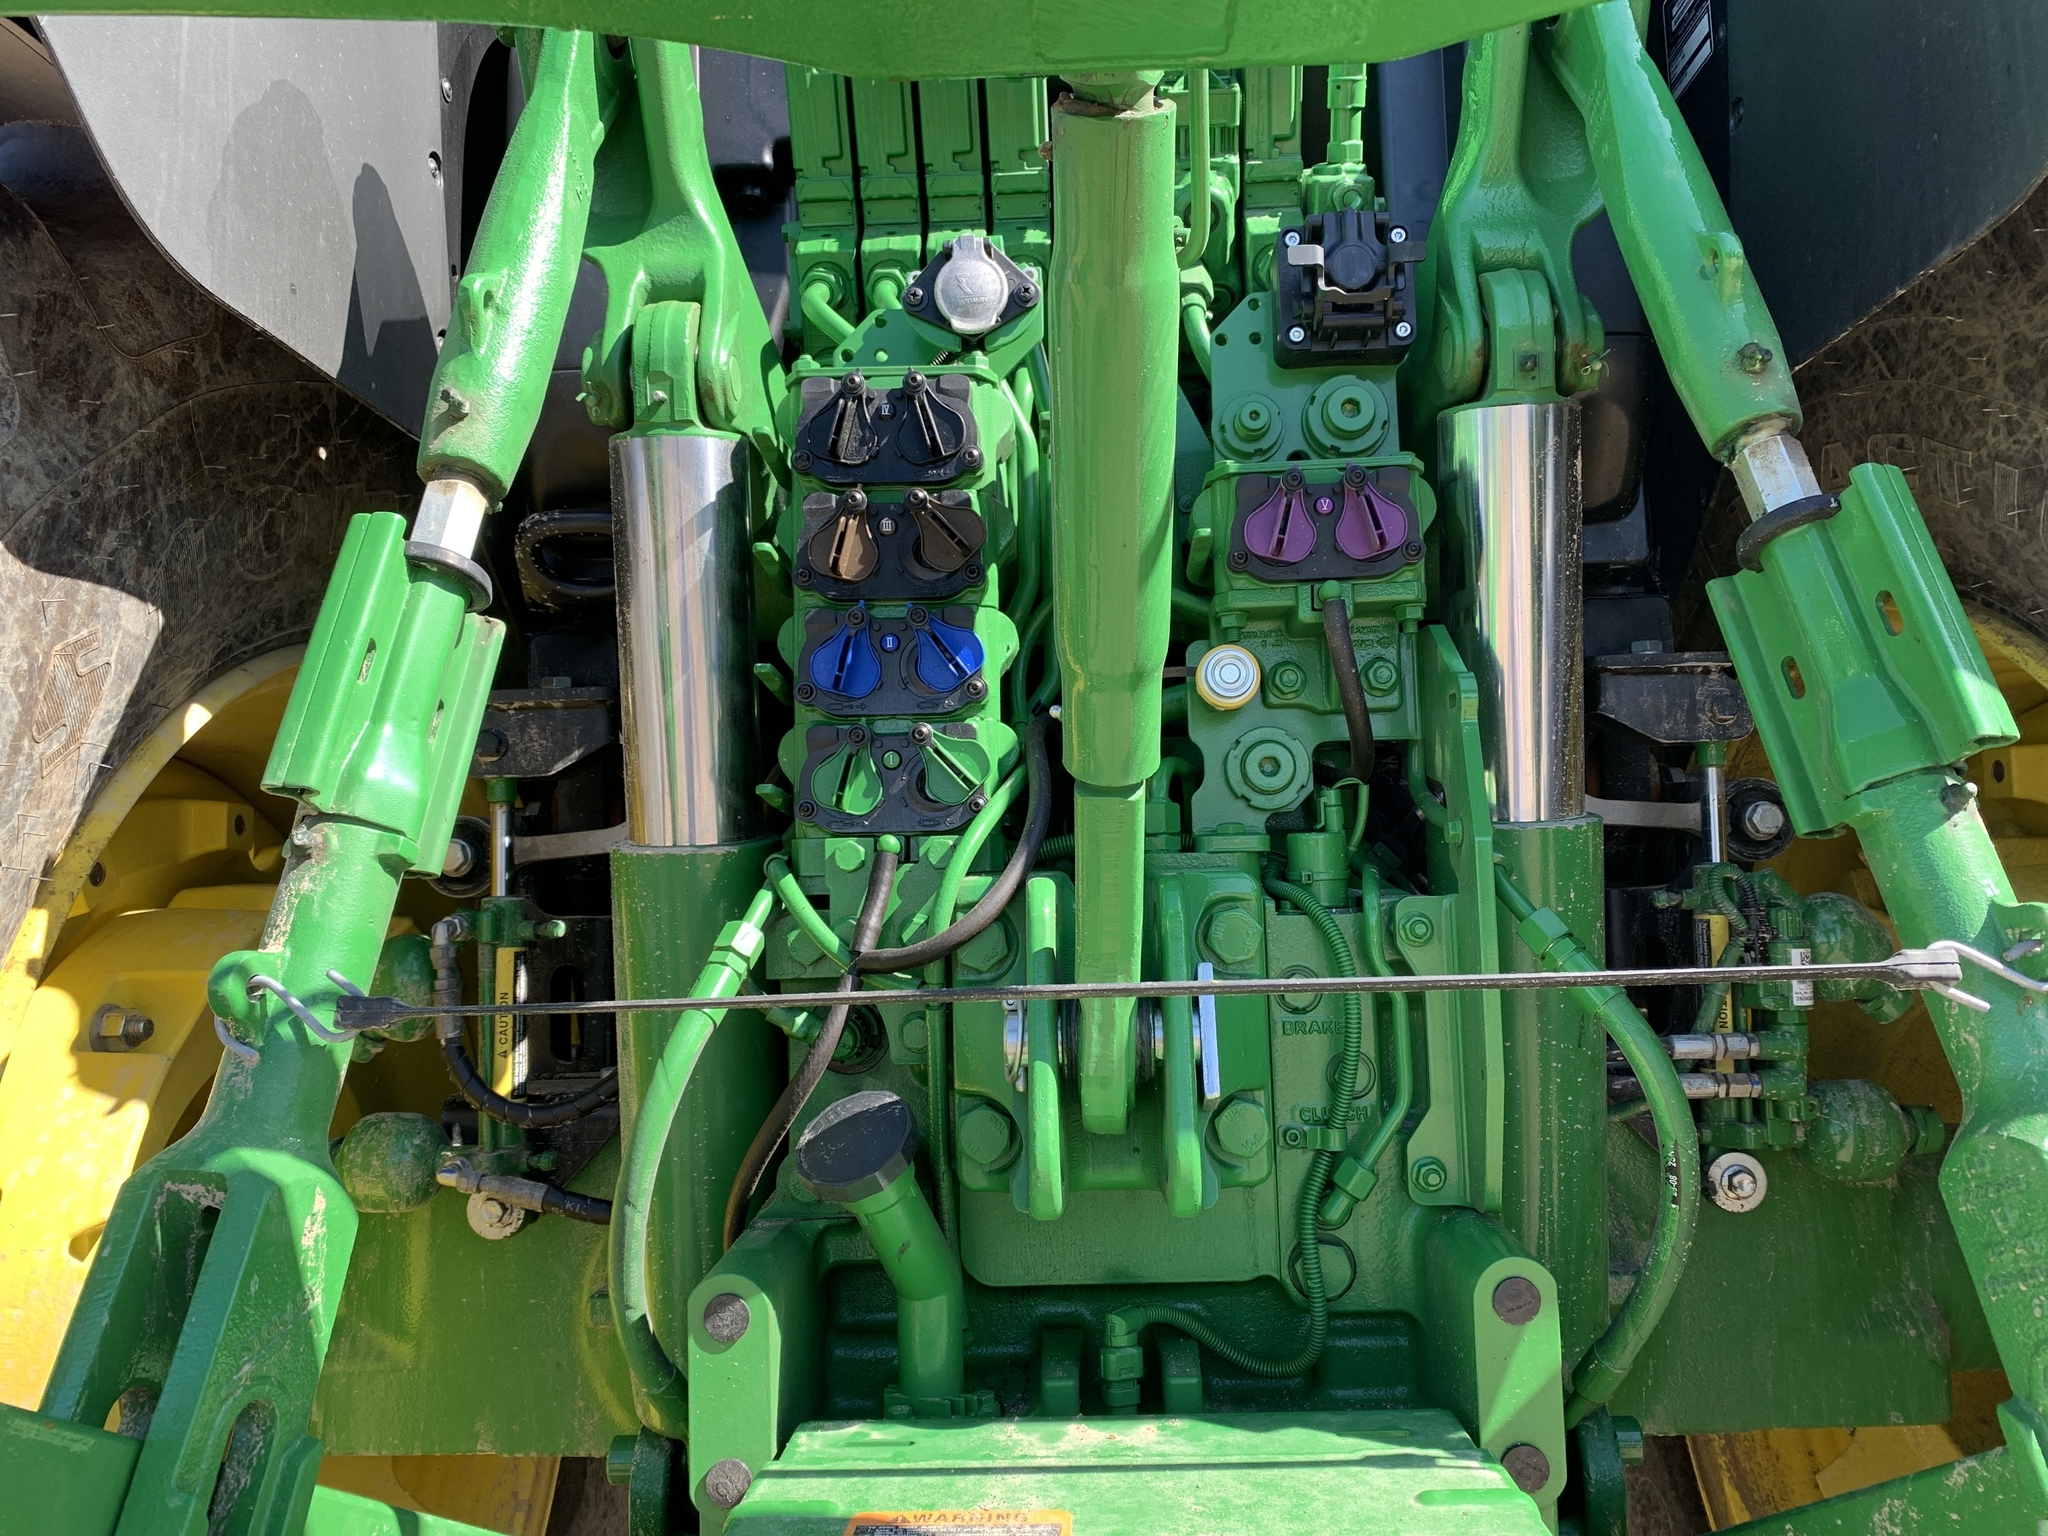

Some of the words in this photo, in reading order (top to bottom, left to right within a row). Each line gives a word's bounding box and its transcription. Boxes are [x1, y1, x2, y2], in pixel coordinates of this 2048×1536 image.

[881, 404, 890, 415] IV
[1320, 499, 1330, 511] V
[882, 520, 892, 532] III
[886, 637, 894, 648] II
[499, 992, 509, 1045] CAUTON
[1282, 1020, 1345, 1036] BRAKE
[1299, 1104, 1368, 1122] CLUCH
[913, 1513, 1028, 1523] WARNING
